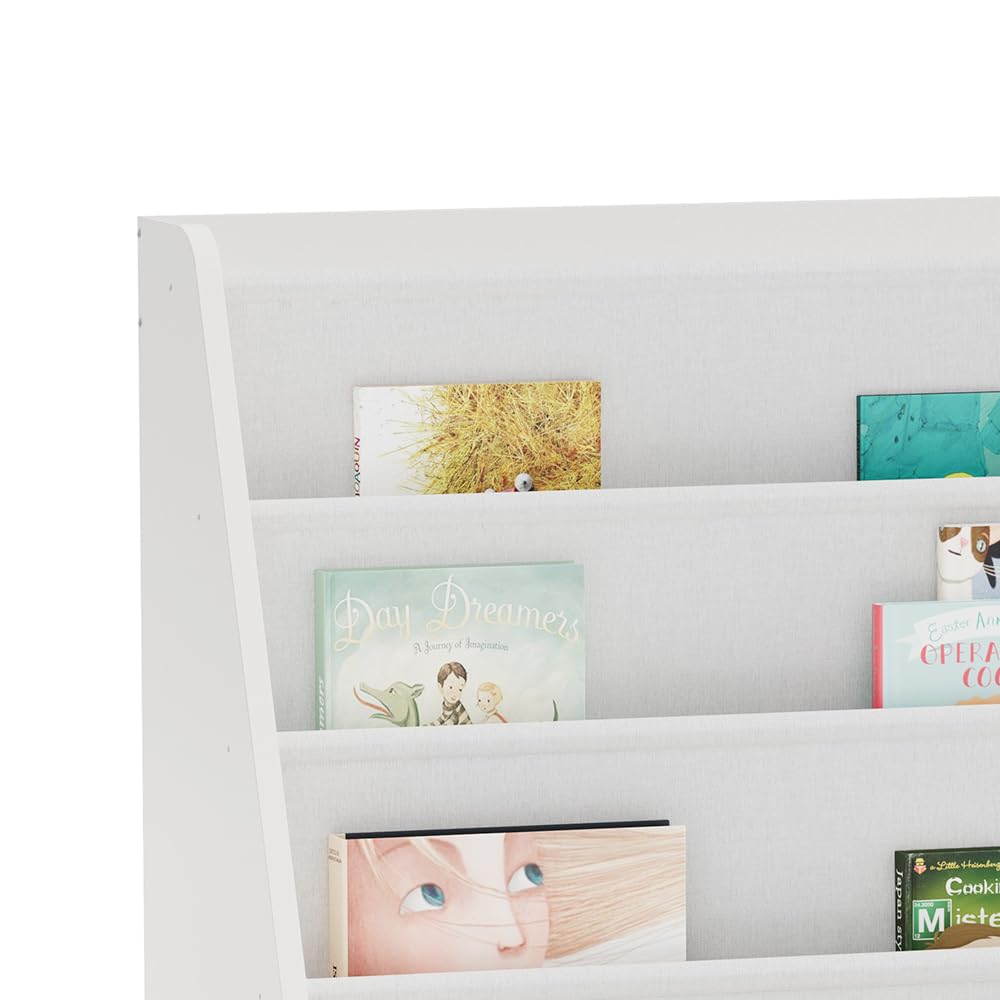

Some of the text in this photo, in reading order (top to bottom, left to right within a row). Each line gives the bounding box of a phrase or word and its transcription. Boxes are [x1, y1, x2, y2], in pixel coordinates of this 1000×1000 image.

[333, 574, 580, 652] Day Dreamers
[936, 860, 960, 871] Little
[895, 868, 904, 920] Japan
